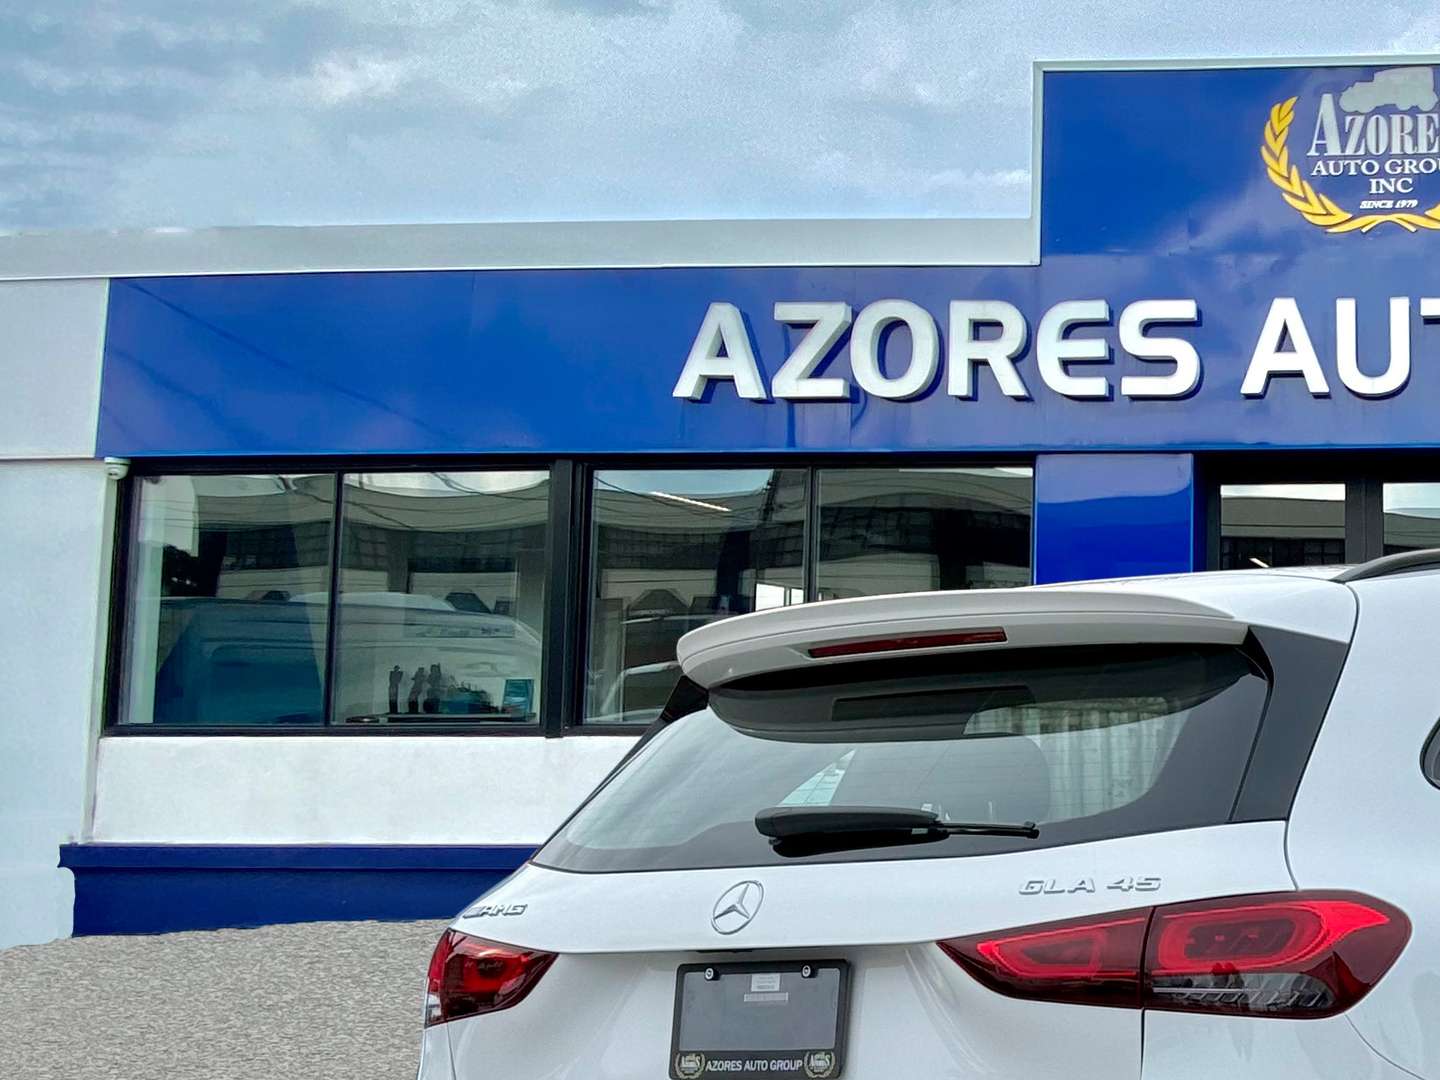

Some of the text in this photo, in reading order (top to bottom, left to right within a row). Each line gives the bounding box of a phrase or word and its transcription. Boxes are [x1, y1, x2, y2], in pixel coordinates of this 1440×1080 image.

[1310, 159, 1380, 176] AUTO
[1368, 178, 1414, 194] INC
[1359, 199, 1419, 209] SINCE 1979
[672, 299, 1202, 401] AZORES
[1018, 877, 1162, 896] GLA 45
[479, 904, 528, 918] AMG
[705, 1060, 742, 1072] AZORES
[744, 1060, 768, 1071] AUTO
[769, 1060, 803, 1072] GROUP
